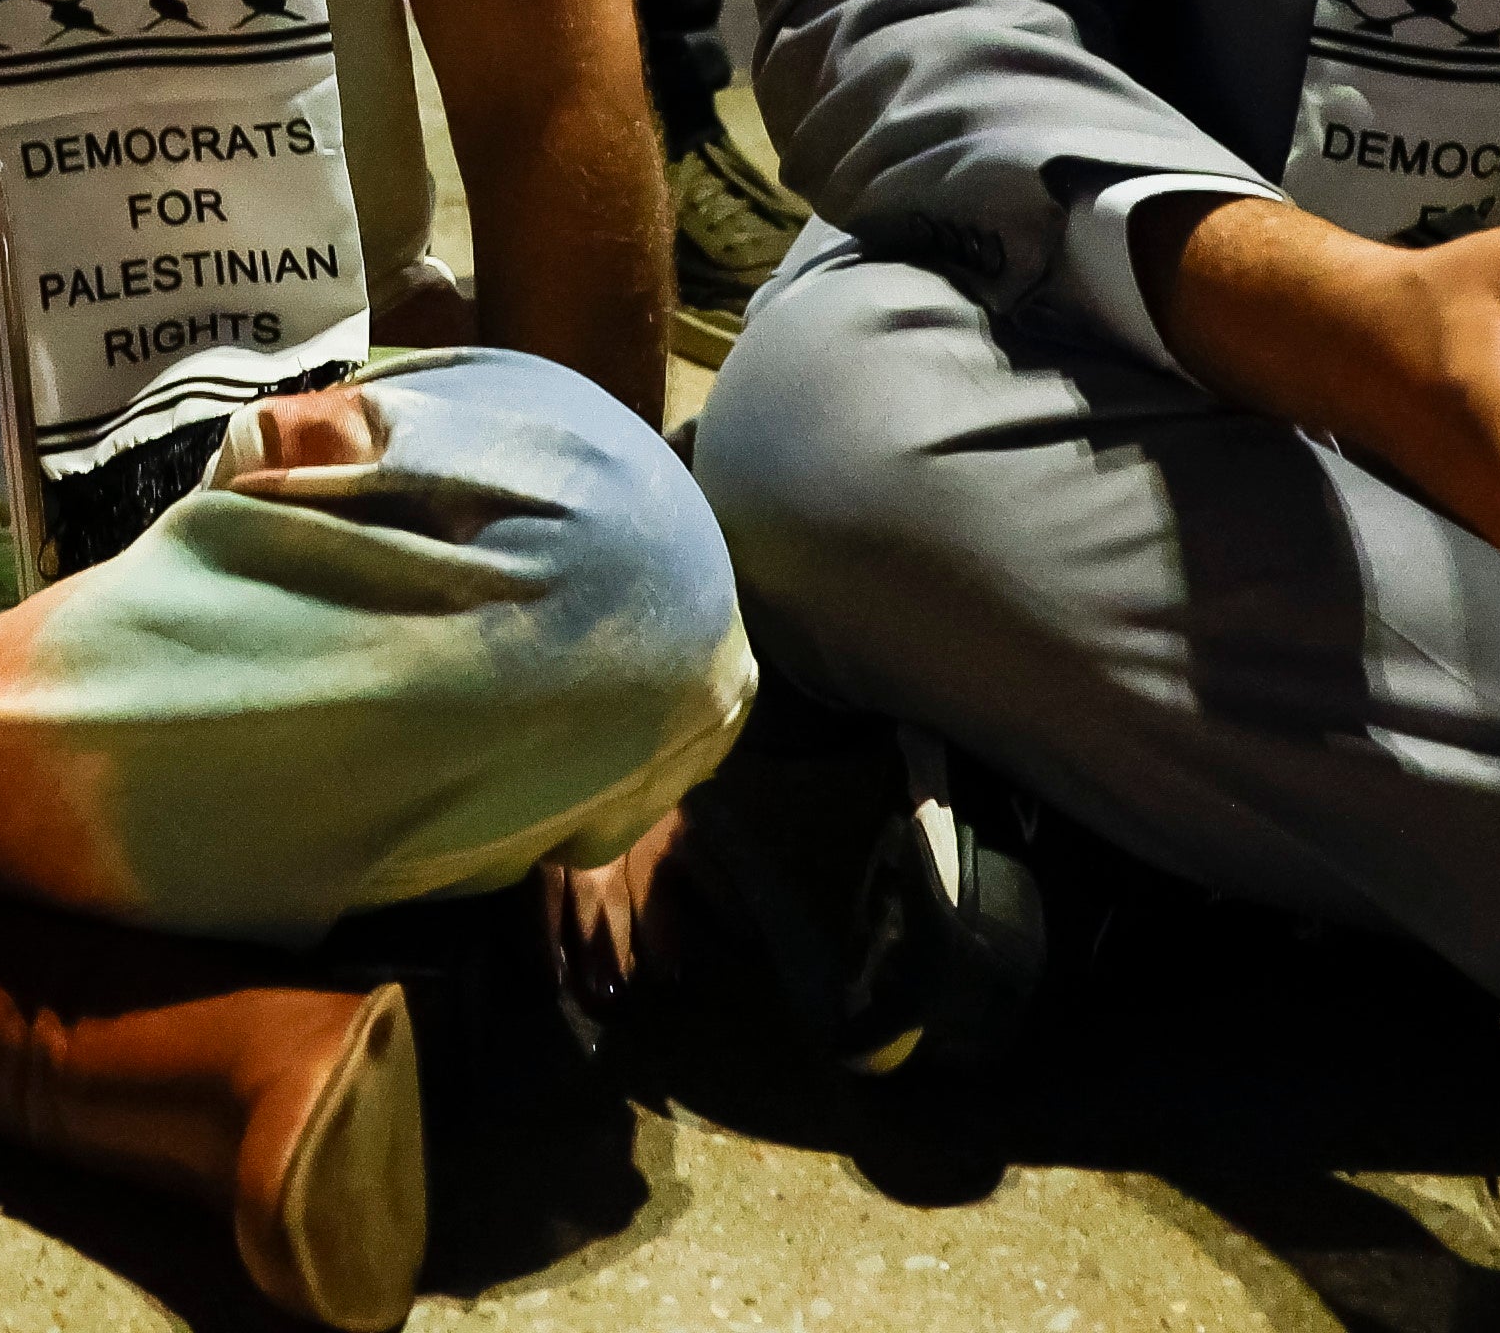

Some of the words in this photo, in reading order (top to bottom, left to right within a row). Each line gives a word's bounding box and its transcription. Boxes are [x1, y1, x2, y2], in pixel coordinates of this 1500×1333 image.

[20, 117, 315, 180] DEMOCRATS
[128, 188, 229, 230] FOR
[39, 244, 339, 312] PALESTINIAN
[104, 311, 282, 368] RIGHTS
